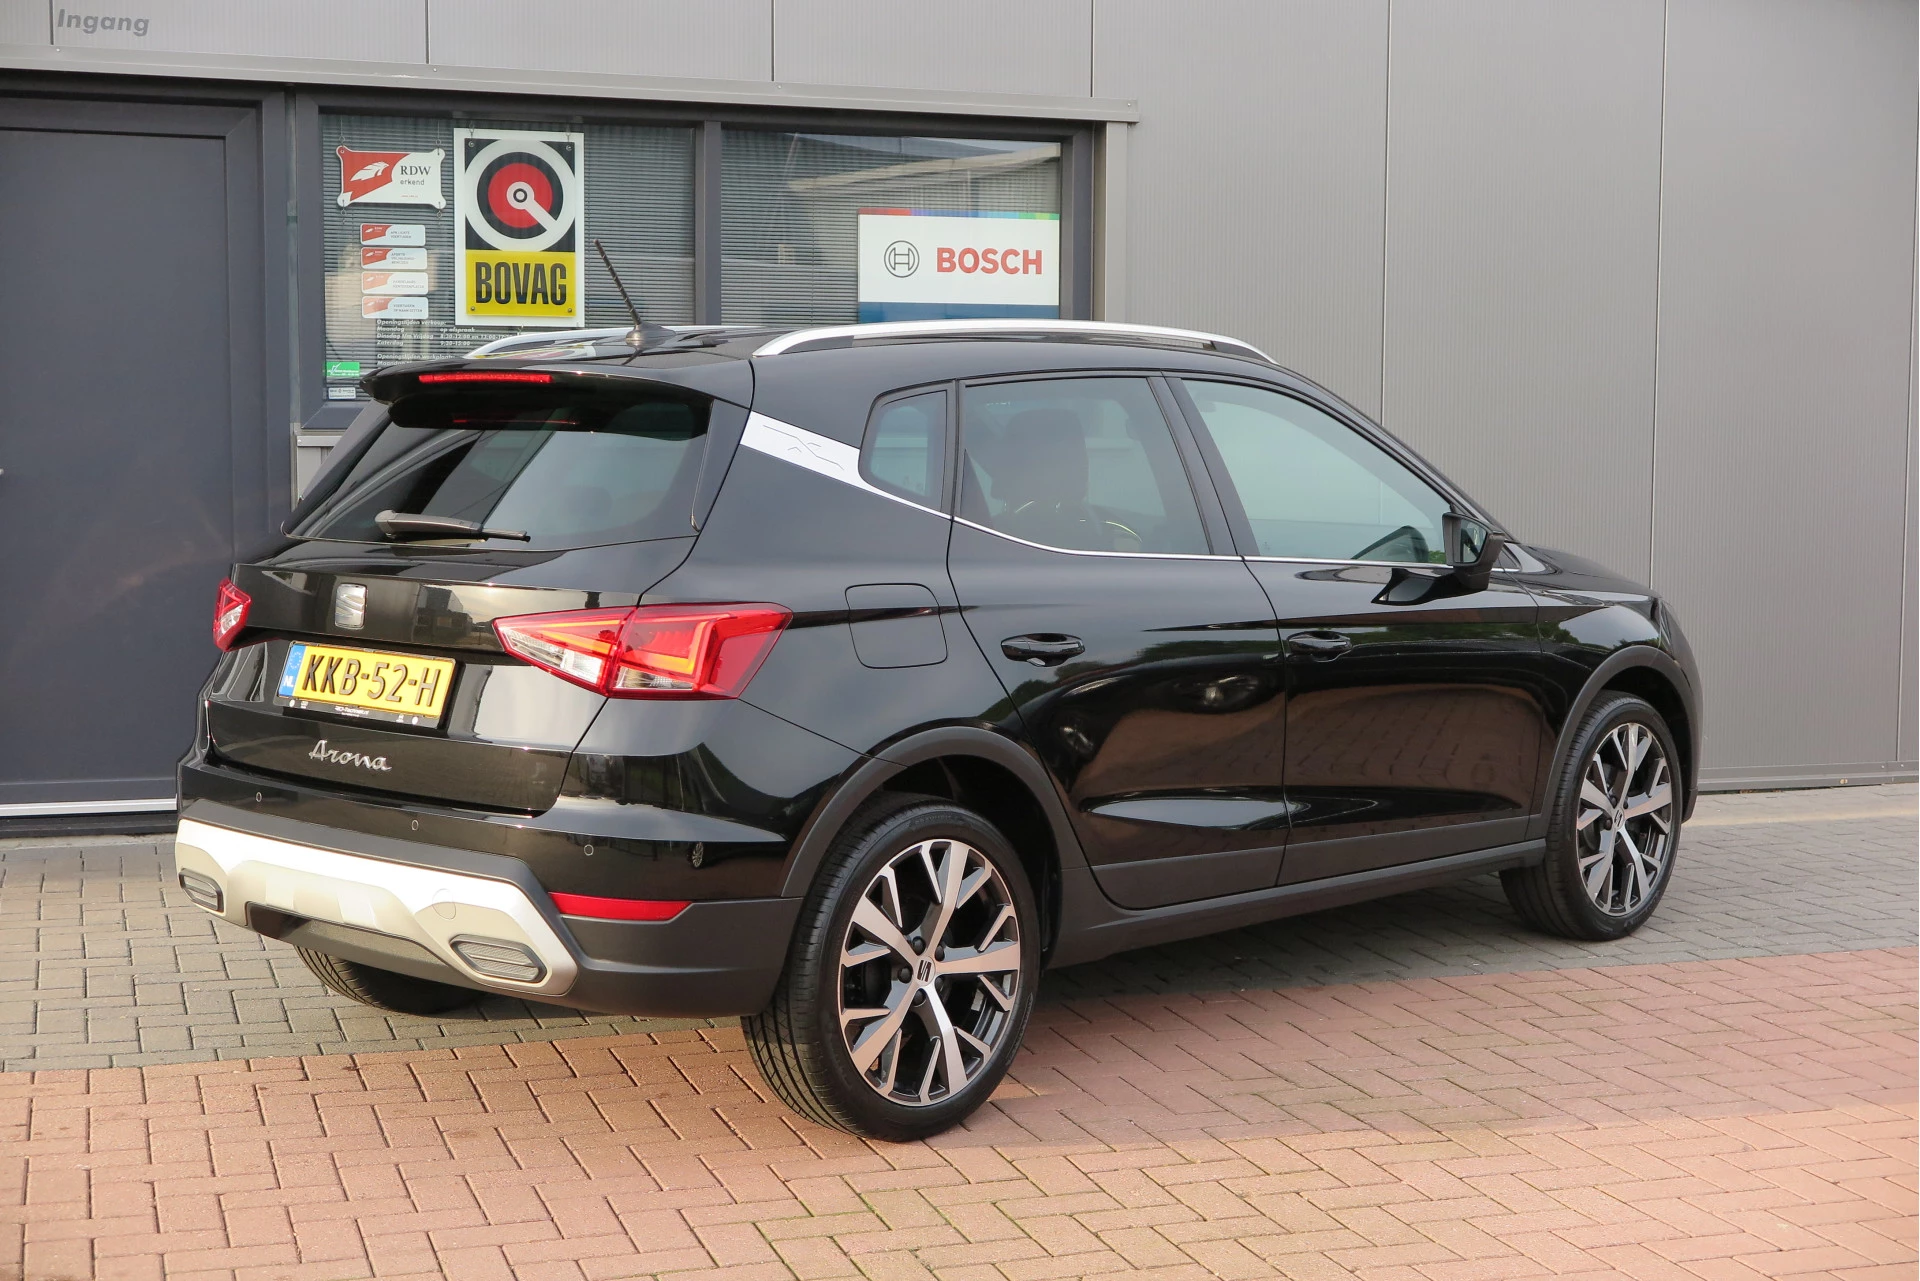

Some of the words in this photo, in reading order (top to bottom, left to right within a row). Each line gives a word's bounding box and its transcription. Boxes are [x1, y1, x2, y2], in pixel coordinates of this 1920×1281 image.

[57, 8, 149, 37] Ingang
[400, 165, 431, 176] RDW
[936, 247, 1042, 275] BOSCH
[475, 261, 567, 306] BOVAG
[283, 675, 294, 687] NL
[302, 654, 441, 707] KKB-52-H
[308, 739, 393, 771] Arona
